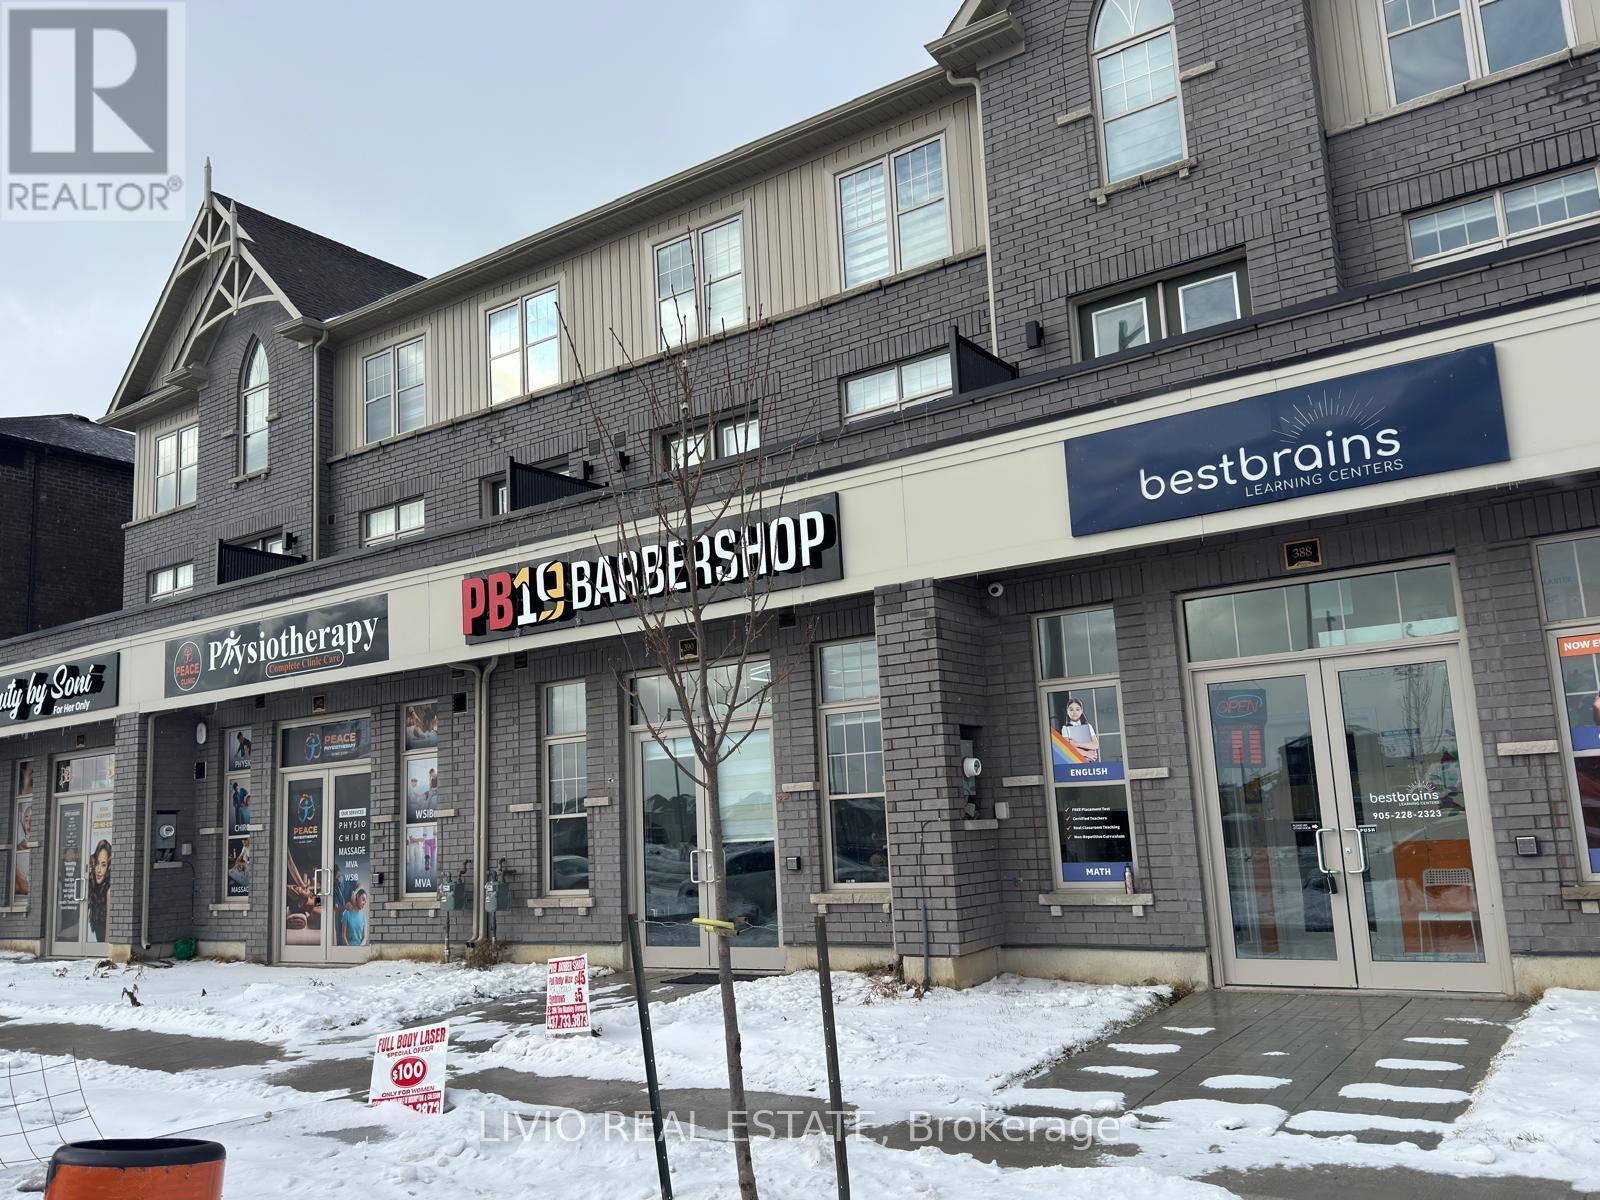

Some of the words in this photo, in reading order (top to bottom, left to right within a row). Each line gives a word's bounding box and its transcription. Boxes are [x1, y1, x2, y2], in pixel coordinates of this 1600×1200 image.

[1140, 428, 1401, 500] bestbrains
[1245, 474, 1323, 497] LEARNING
[1328, 458, 1404, 482] CENTERS
[1292, 546, 1312, 558] 388
[462, 560, 565, 636] PB19
[571, 510, 825, 611] BARBERSHOP
[1563, 641, 1591, 652] NOW
[175, 662, 200, 678] PEACE
[268, 661, 300, 673] Complete
[301, 657, 322, 668] Clinic
[323, 654, 342, 665] Care
[26, 672, 48, 715] by
[51, 664, 94, 699] Soni
[53, 705, 63, 715] For
[63, 703, 75, 713] Her
[75, 699, 90, 711] Only
[1216, 699, 1258, 714] OPEN
[324, 732, 357, 744] PEACE
[1070, 767, 1108, 777] ENGLISH
[1369, 790, 1439, 804] bestbrains
[415, 809, 434, 819] WSIB
[1373, 809, 1442, 820] 905-228-2323
[293, 825, 318, 835] PEACE
[339, 820, 366, 830] PHYSIO
[338, 833, 366, 843] CHIRO
[338, 846, 366, 856] MASSAGE
[345, 861, 359, 869] MVA
[1085, 867, 1112, 876] MATH
[344, 873, 359, 882] WSIB
[414, 878, 431, 888] MVA
[574, 970, 585, 985] $45
[575, 987, 583, 1002] $5
[377, 1036, 394, 1053] FULL
[396, 1032, 419, 1049] BODY
[420, 1027, 446, 1046] LASER
[387, 1050, 411, 1058] SPECIAL
[413, 1045, 433, 1054] OFFER
[392, 1061, 424, 1081] $100
[381, 1090, 397, 1098] ONLY
[398, 1088, 410, 1096] FOR
[411, 1085, 435, 1094] WOMEN
